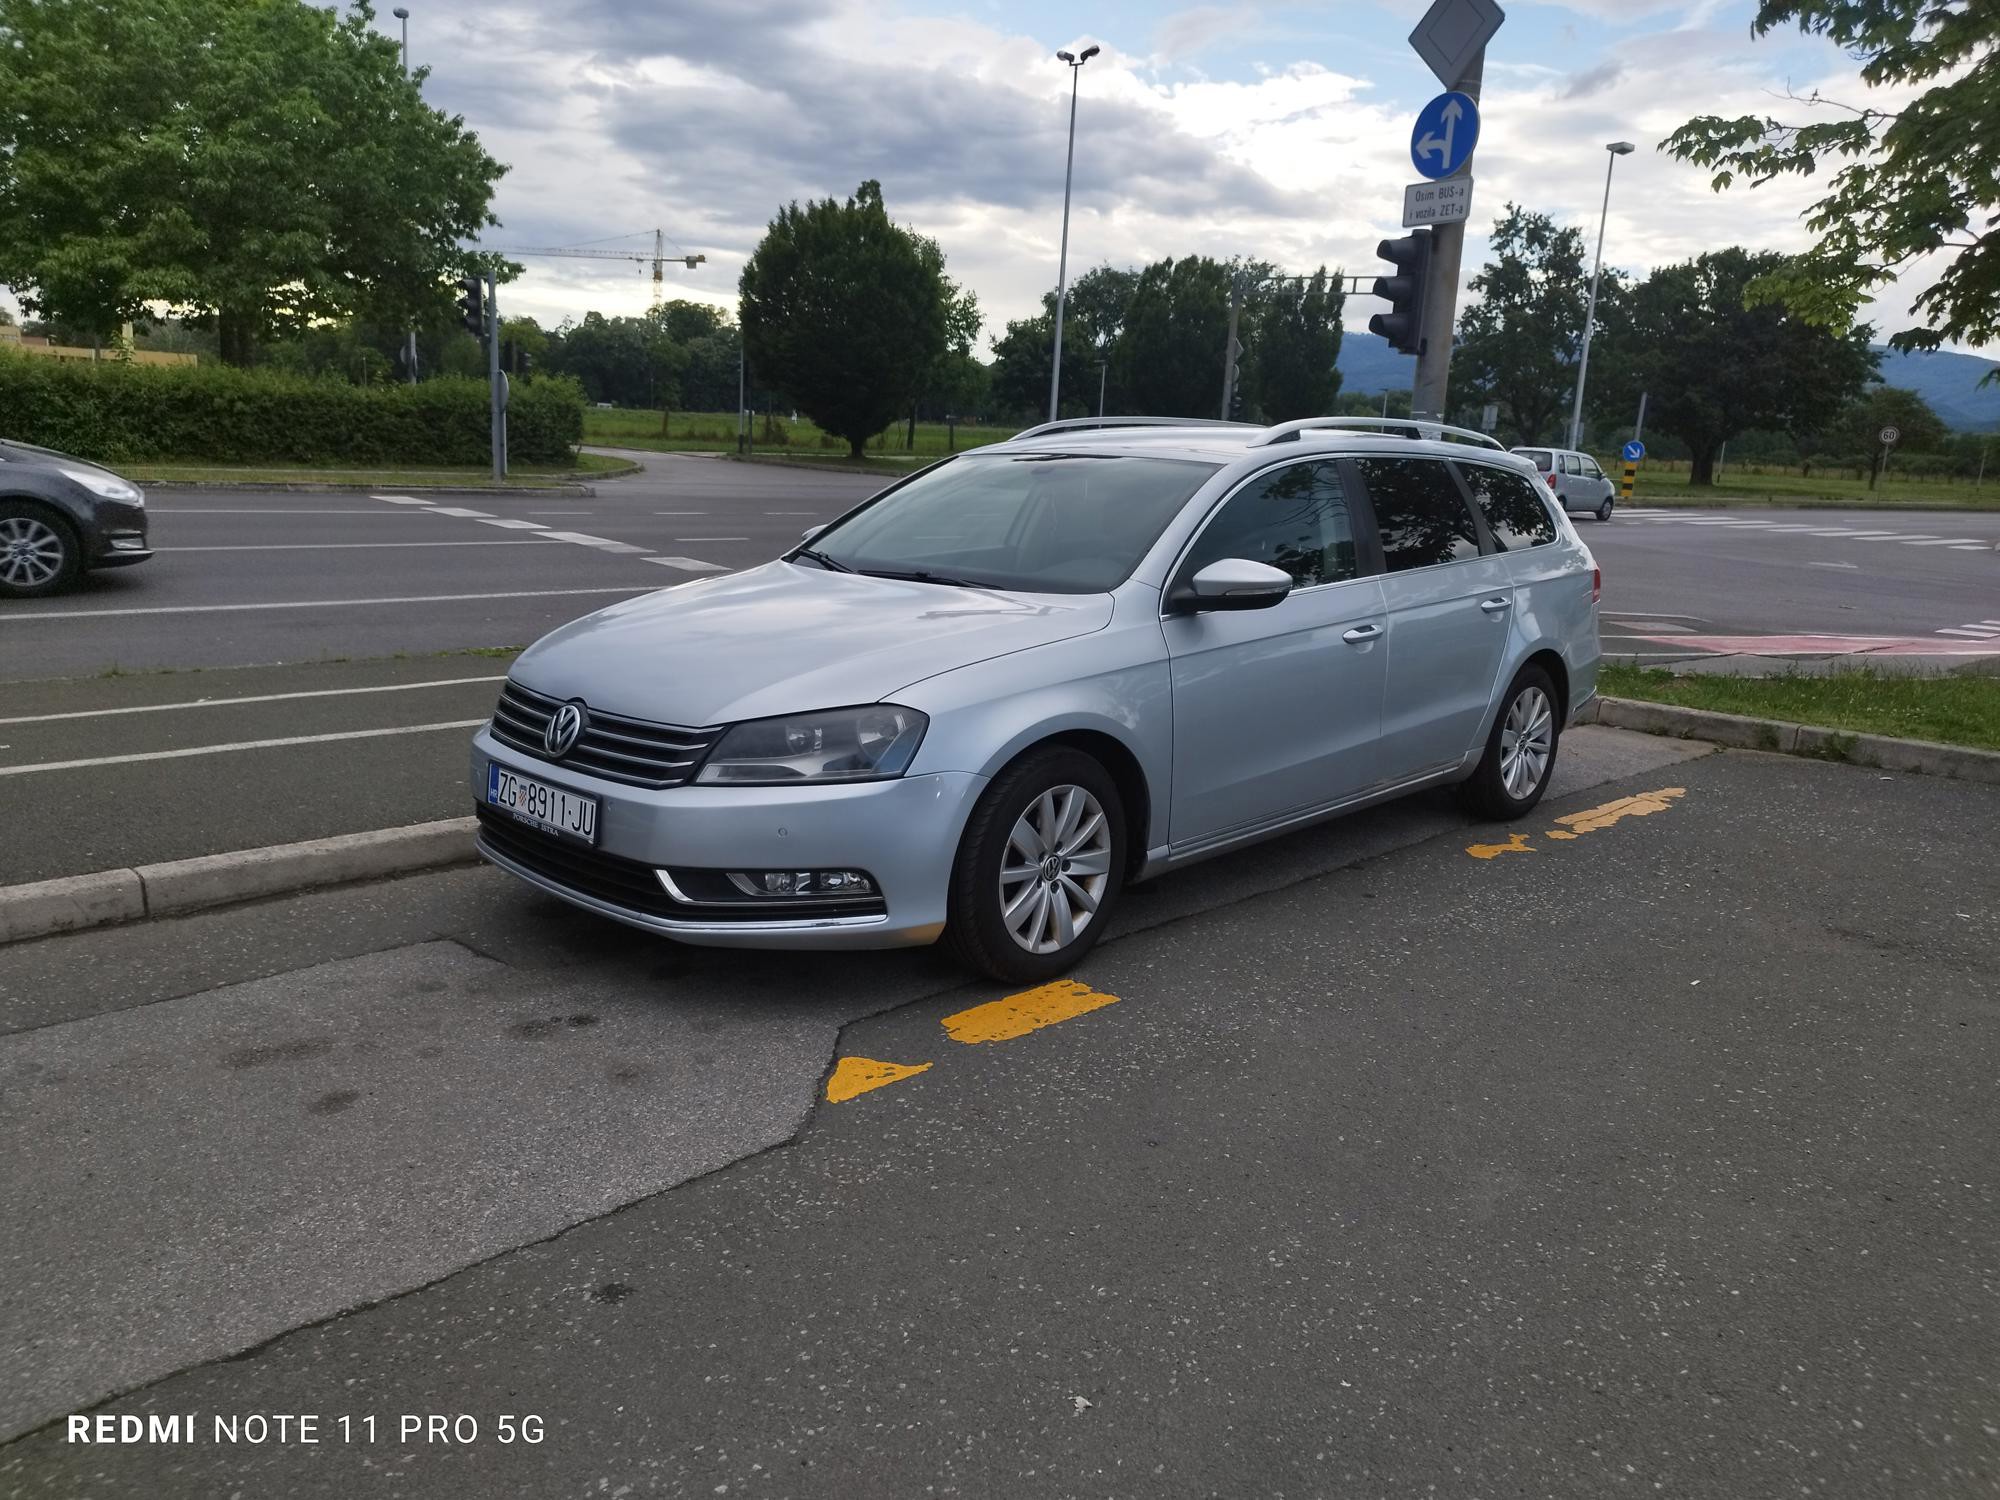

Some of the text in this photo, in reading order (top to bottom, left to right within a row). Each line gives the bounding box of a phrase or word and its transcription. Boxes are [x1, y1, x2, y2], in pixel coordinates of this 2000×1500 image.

[1415, 186, 1464, 202] Osim BUS-a
[1415, 206, 1436, 219] vozila
[1440, 203, 1464, 217] ZET-a
[1883, 431, 1895, 440] 60
[499, 772, 517, 807] ZG
[513, 812, 559, 837] PORSCHE ISTRA
